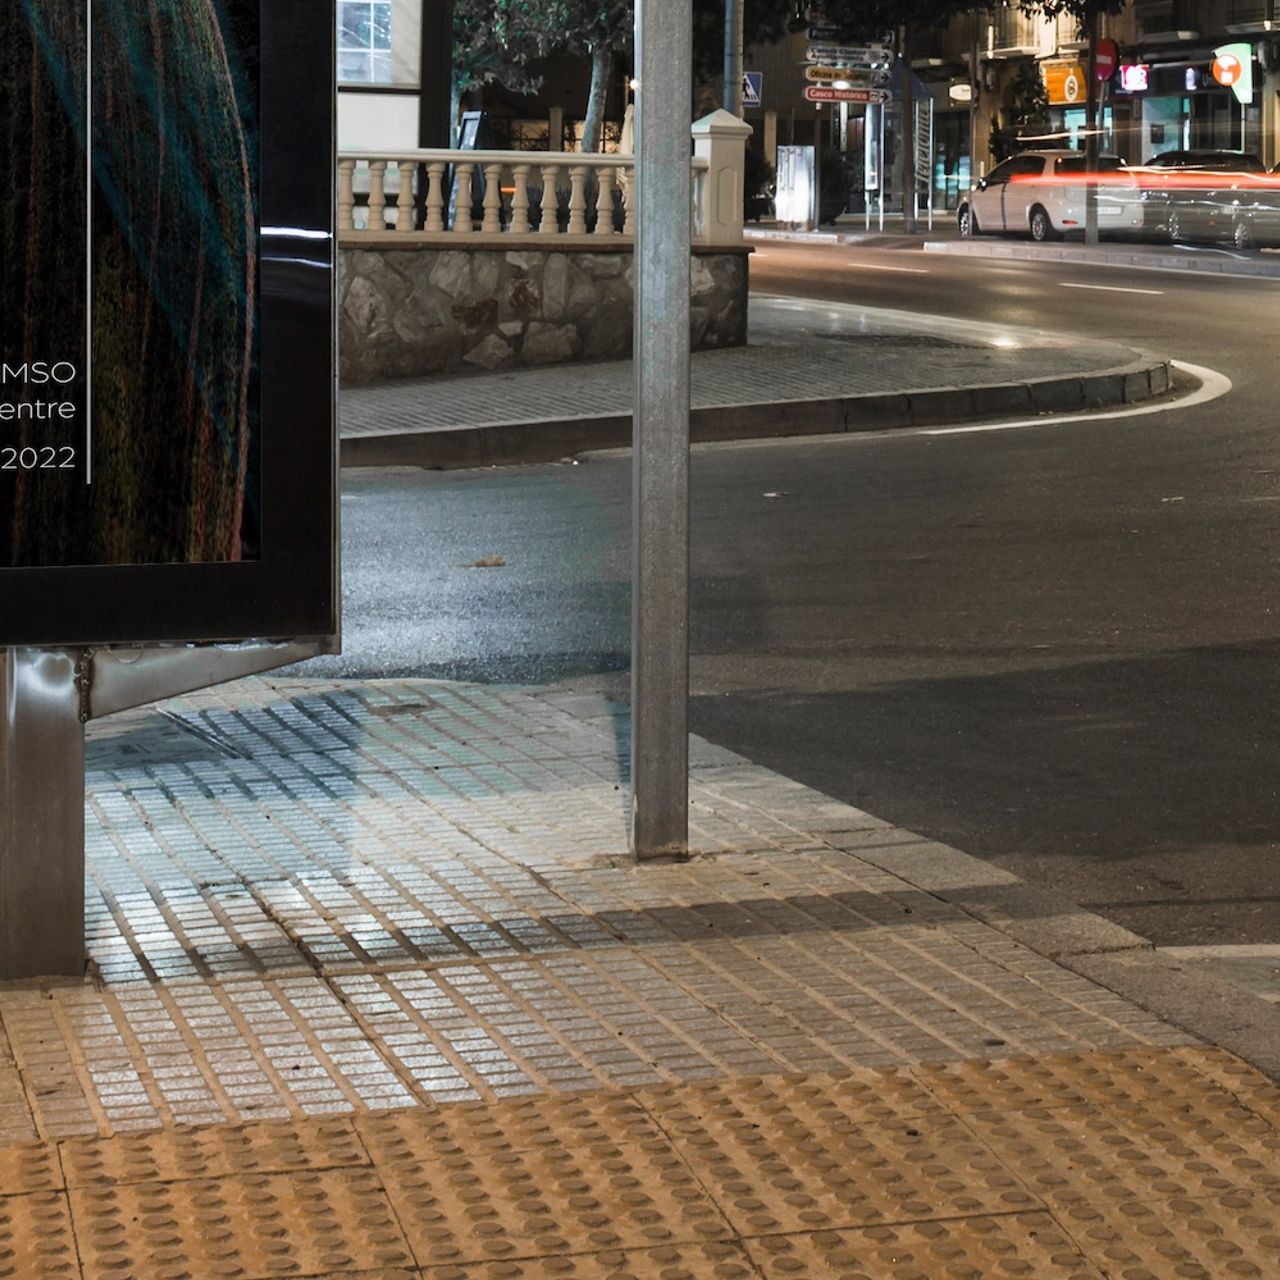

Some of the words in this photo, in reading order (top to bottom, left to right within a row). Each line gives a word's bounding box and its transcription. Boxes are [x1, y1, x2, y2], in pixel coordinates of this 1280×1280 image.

[810, 89, 833, 98] Casco
[834, 90, 868, 100] Histórico
[2, 361, 76, 385] MSO
